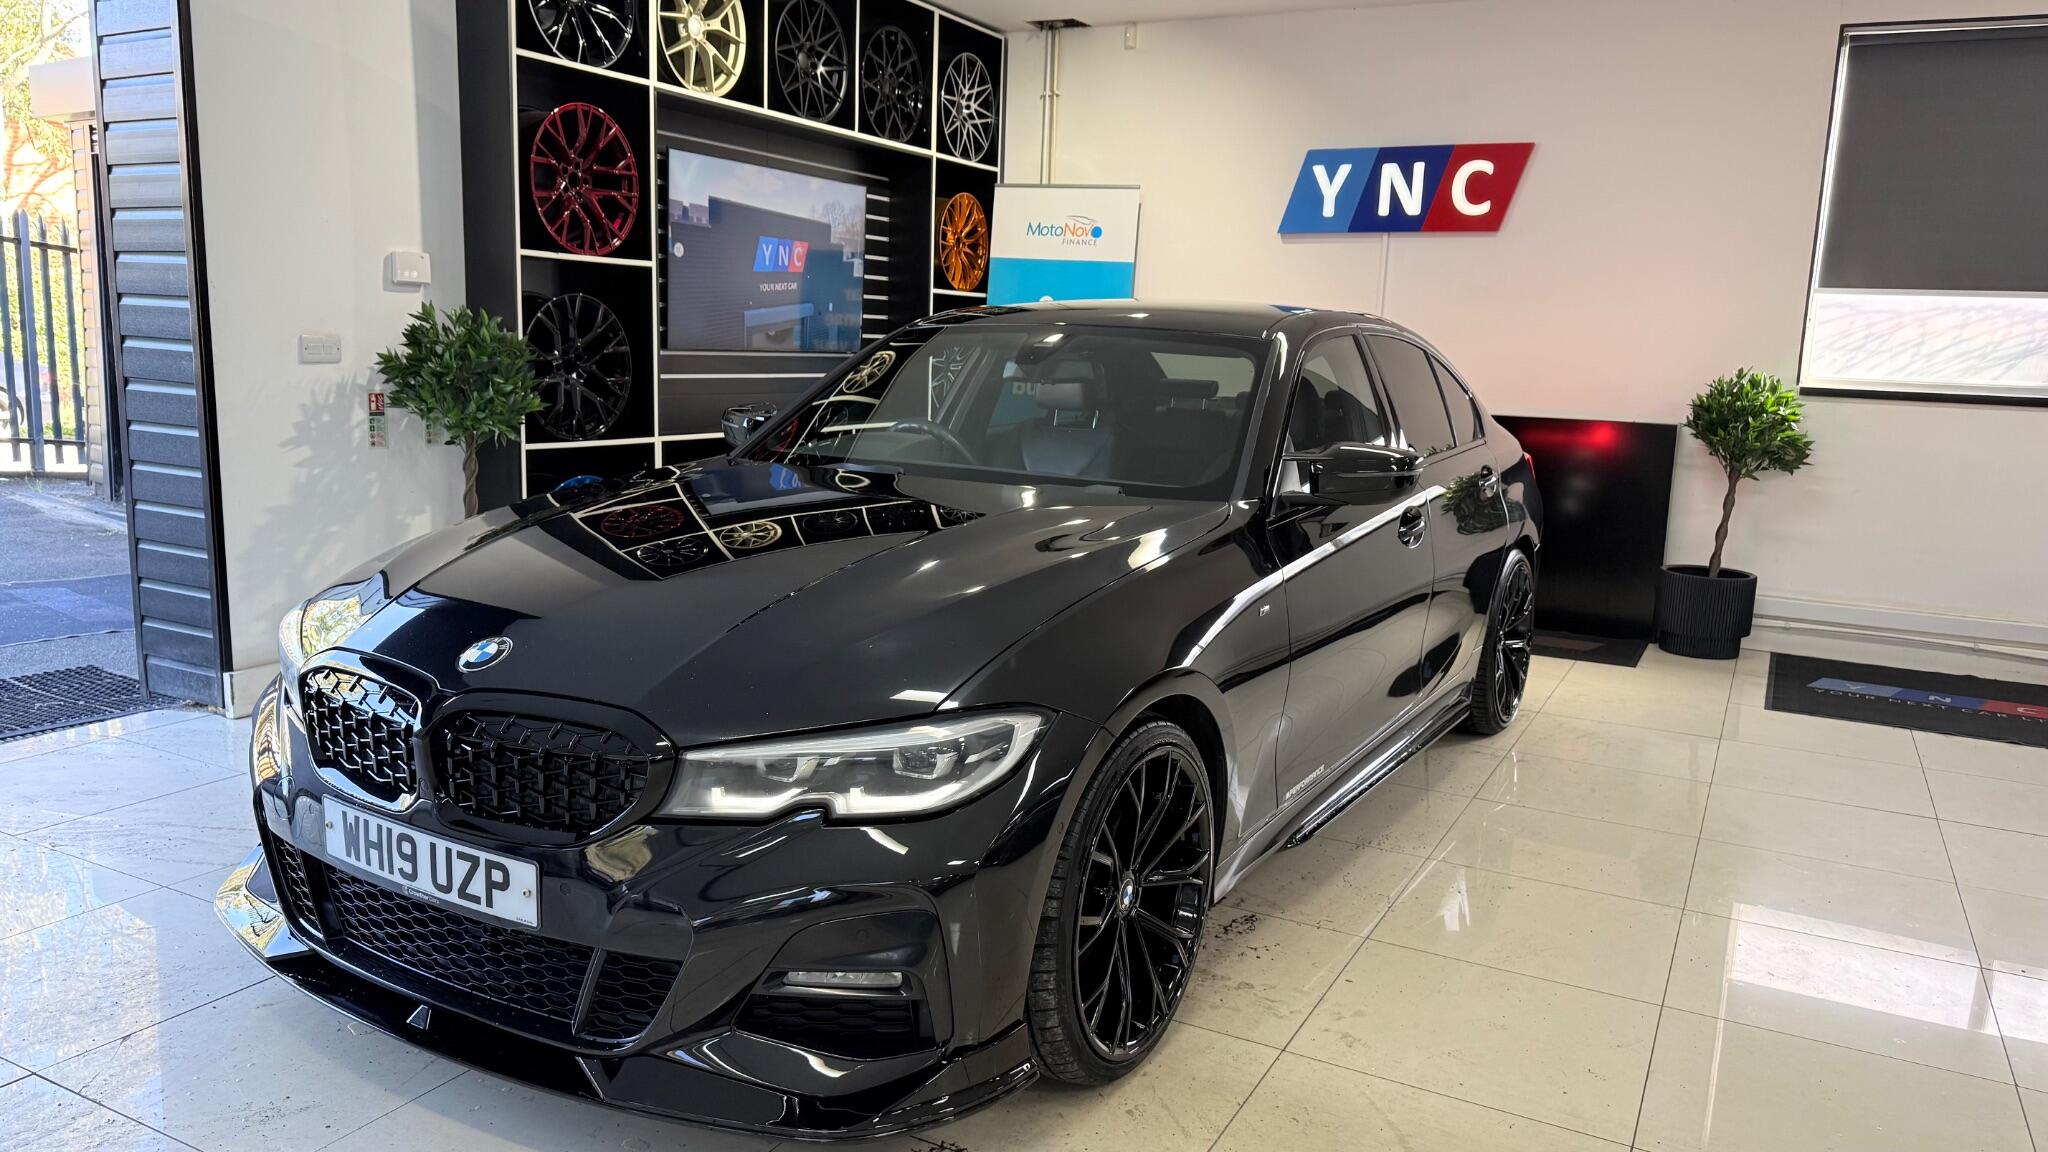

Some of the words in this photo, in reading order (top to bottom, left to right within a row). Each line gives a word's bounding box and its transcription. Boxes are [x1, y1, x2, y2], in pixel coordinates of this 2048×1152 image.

[1312, 159, 1495, 218] YNC
[762, 243, 802, 267] YNC
[1062, 238, 1097, 246] FINANCE
[760, 282, 774, 292] YOUR
[1815, 688, 1875, 700] YOUR
[1889, 698, 1948, 710] NEXT
[1961, 708, 2008, 718] CAR
[341, 810, 418, 883] WH19
[429, 841, 511, 909] UZP
